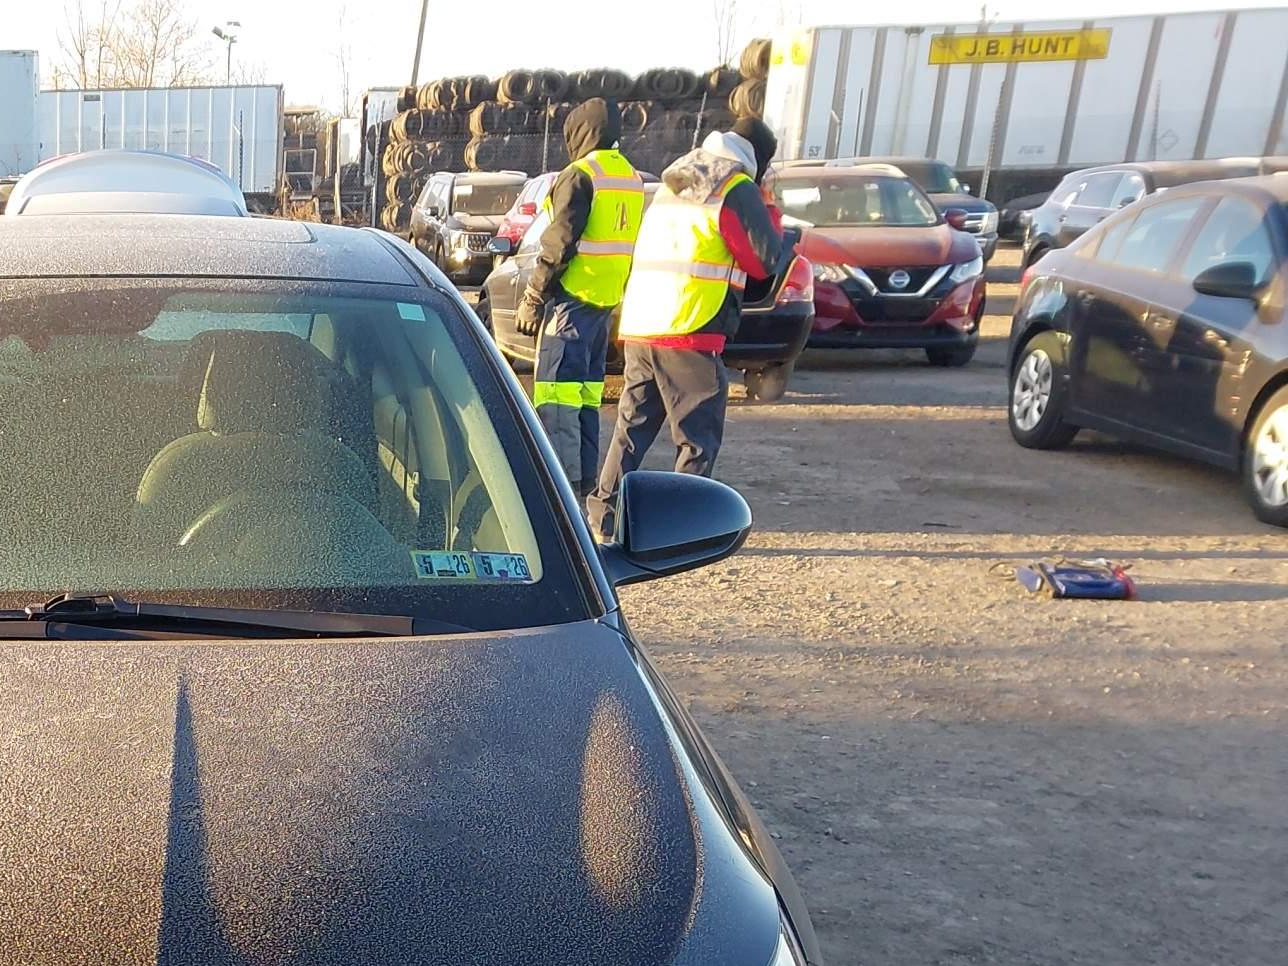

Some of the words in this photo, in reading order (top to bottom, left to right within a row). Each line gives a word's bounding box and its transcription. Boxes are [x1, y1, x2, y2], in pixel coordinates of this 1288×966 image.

[1011, 36, 1074, 55] HUNT
[422, 555, 434, 575] 5
[452, 554, 471, 574] 26
[480, 555, 494, 576] 5
[511, 556, 529, 576] 26
